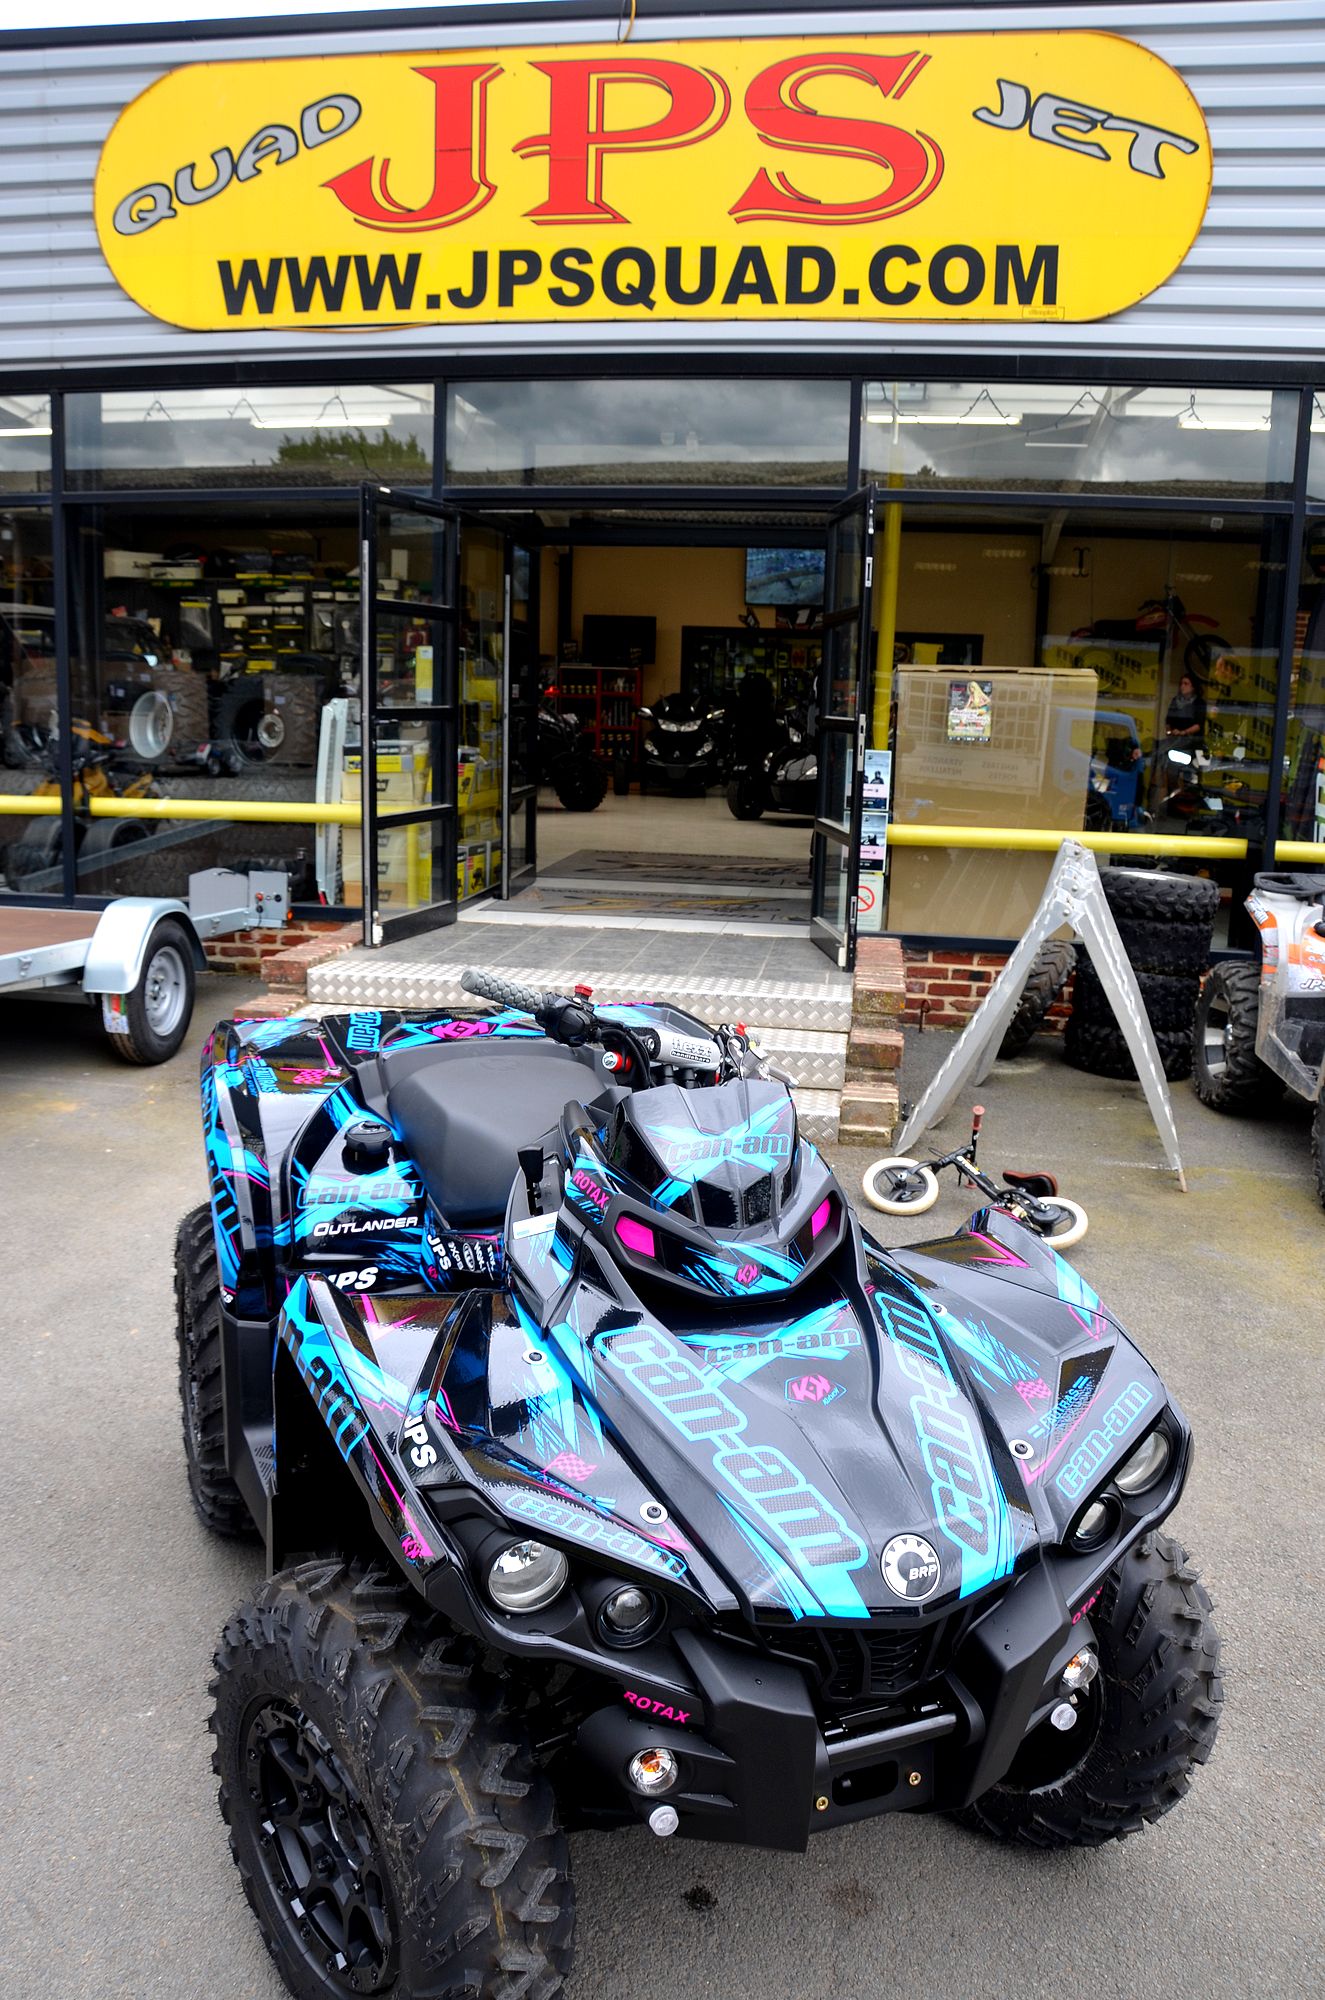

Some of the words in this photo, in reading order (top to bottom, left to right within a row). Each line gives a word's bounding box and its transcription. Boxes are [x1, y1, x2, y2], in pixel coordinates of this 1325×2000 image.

[113, 93, 362, 236] QUAD
[320, 50, 945, 233] JPS
[973, 78, 1199, 179] JET
[217, 244, 1060, 316] WWW.JPSQUAD.COM
[666, 1132, 791, 1165] can-am
[297, 1180, 424, 1209] can-am
[573, 1170, 610, 1208] ROTAX
[313, 1216, 418, 1237] OUTLANDER
[427, 1234, 452, 1271] JPS
[704, 1328, 863, 1367] can-am
[404, 1415, 437, 1468] JPS
[875, 1291, 995, 1556] can-am
[1056, 1382, 1153, 1500] can-am
[593, 1325, 869, 1572] can-am
[505, 1492, 688, 1579] can-am
[909, 1565, 938, 1580] BRP
[624, 1691, 690, 1724] ROTAX
